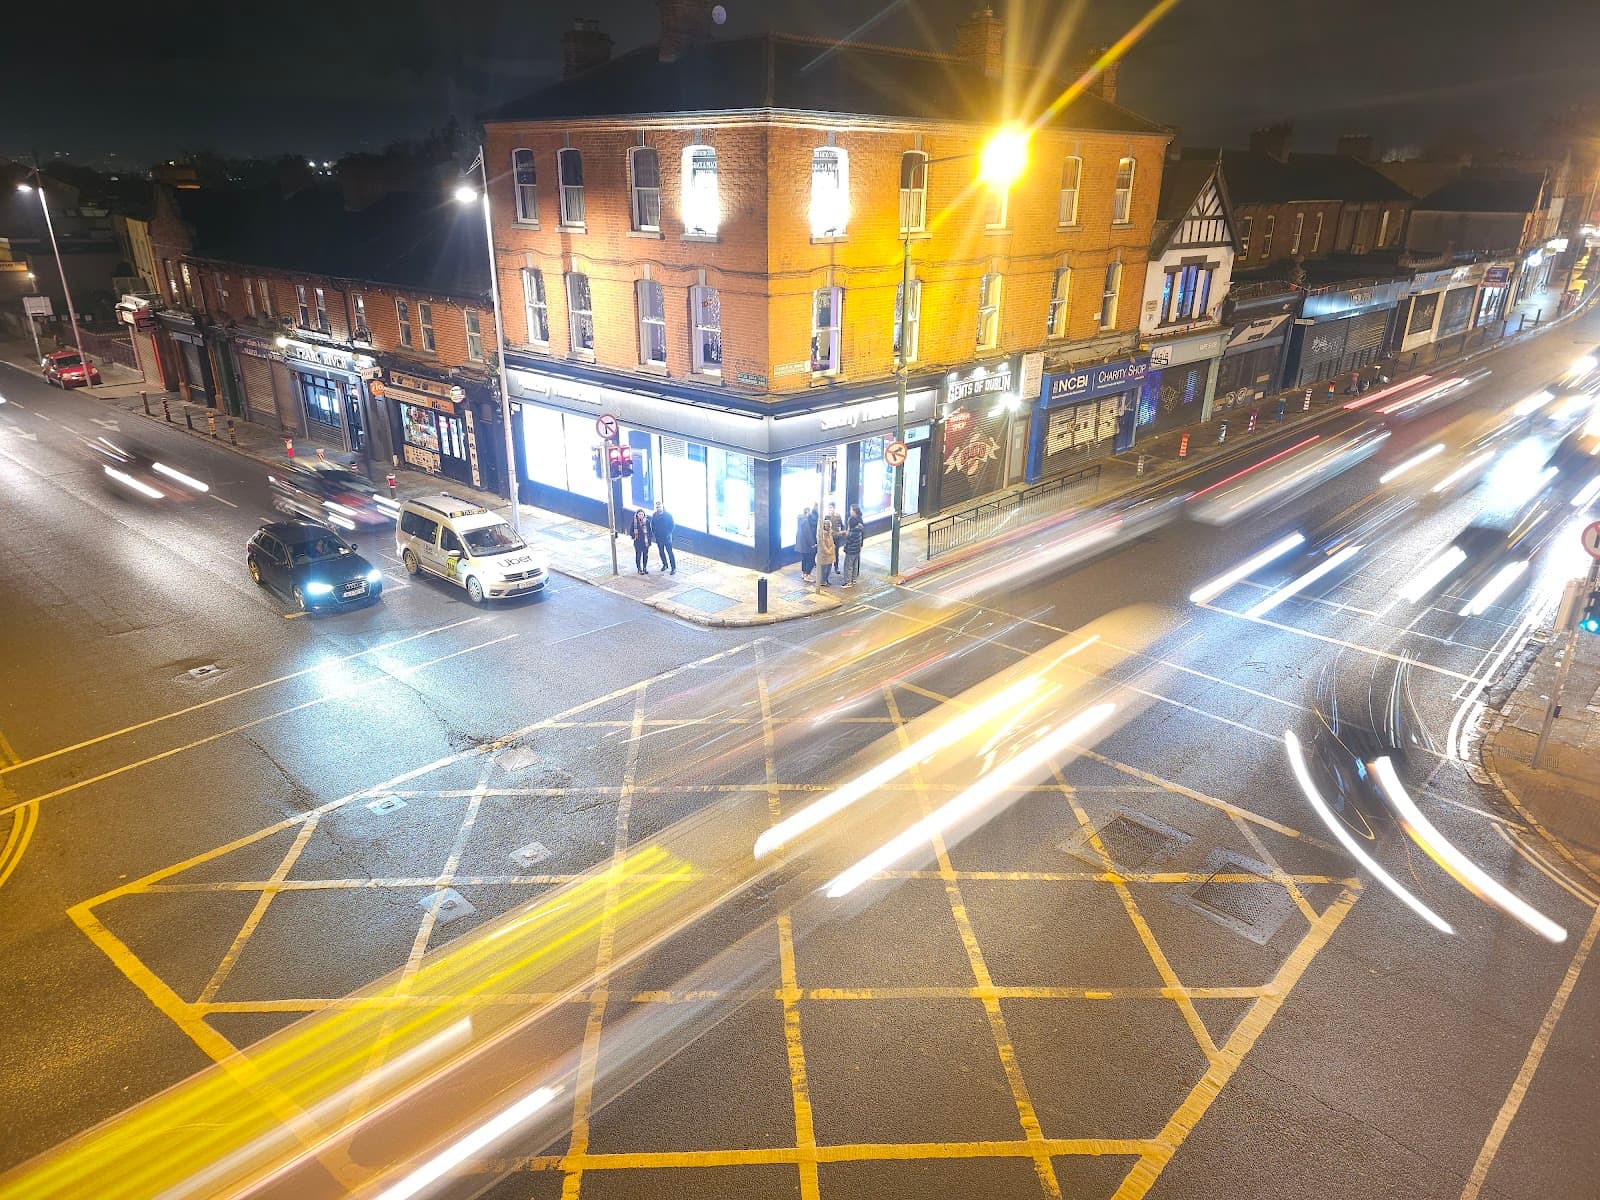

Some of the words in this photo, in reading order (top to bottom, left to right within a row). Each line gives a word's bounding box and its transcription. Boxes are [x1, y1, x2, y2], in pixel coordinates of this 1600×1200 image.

[948, 382, 973, 403] GENTS
[974, 380, 985, 393] OF
[985, 374, 1011, 391] DUBLIN
[1058, 374, 1089, 393] NCBI
[1098, 368, 1127, 383] CHARITY
[1128, 364, 1147, 377] SHOP
[497, 555, 533, 568] Uber
